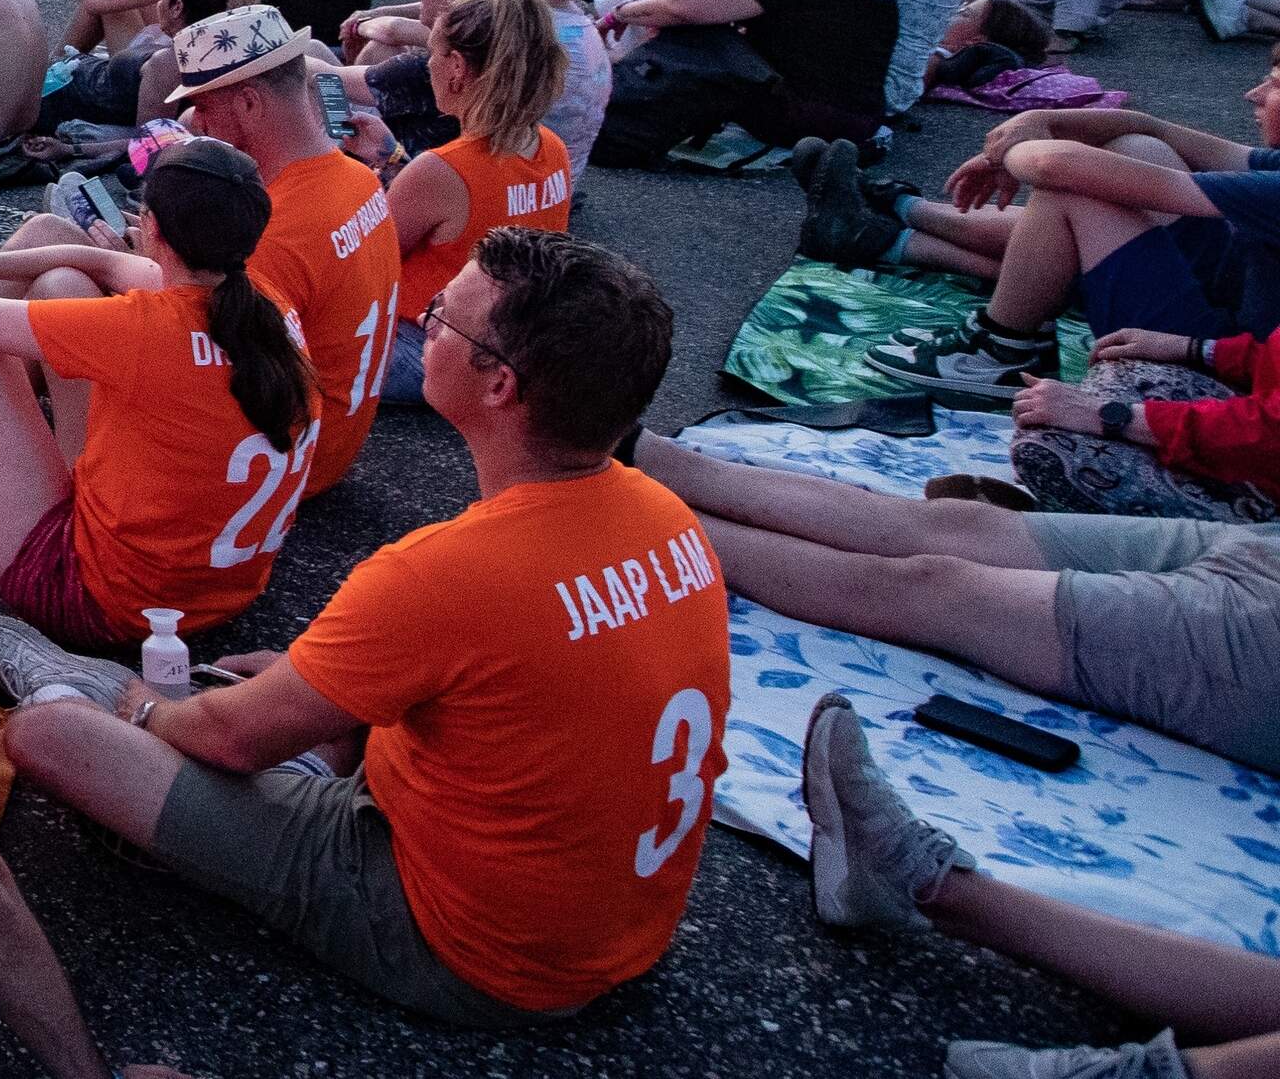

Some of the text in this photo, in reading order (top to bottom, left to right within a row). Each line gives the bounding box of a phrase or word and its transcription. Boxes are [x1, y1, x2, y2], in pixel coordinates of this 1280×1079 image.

[506, 182, 537, 217] NOA
[554, 527, 716, 641] JAAP LAM
[633, 687, 713, 878] 3
